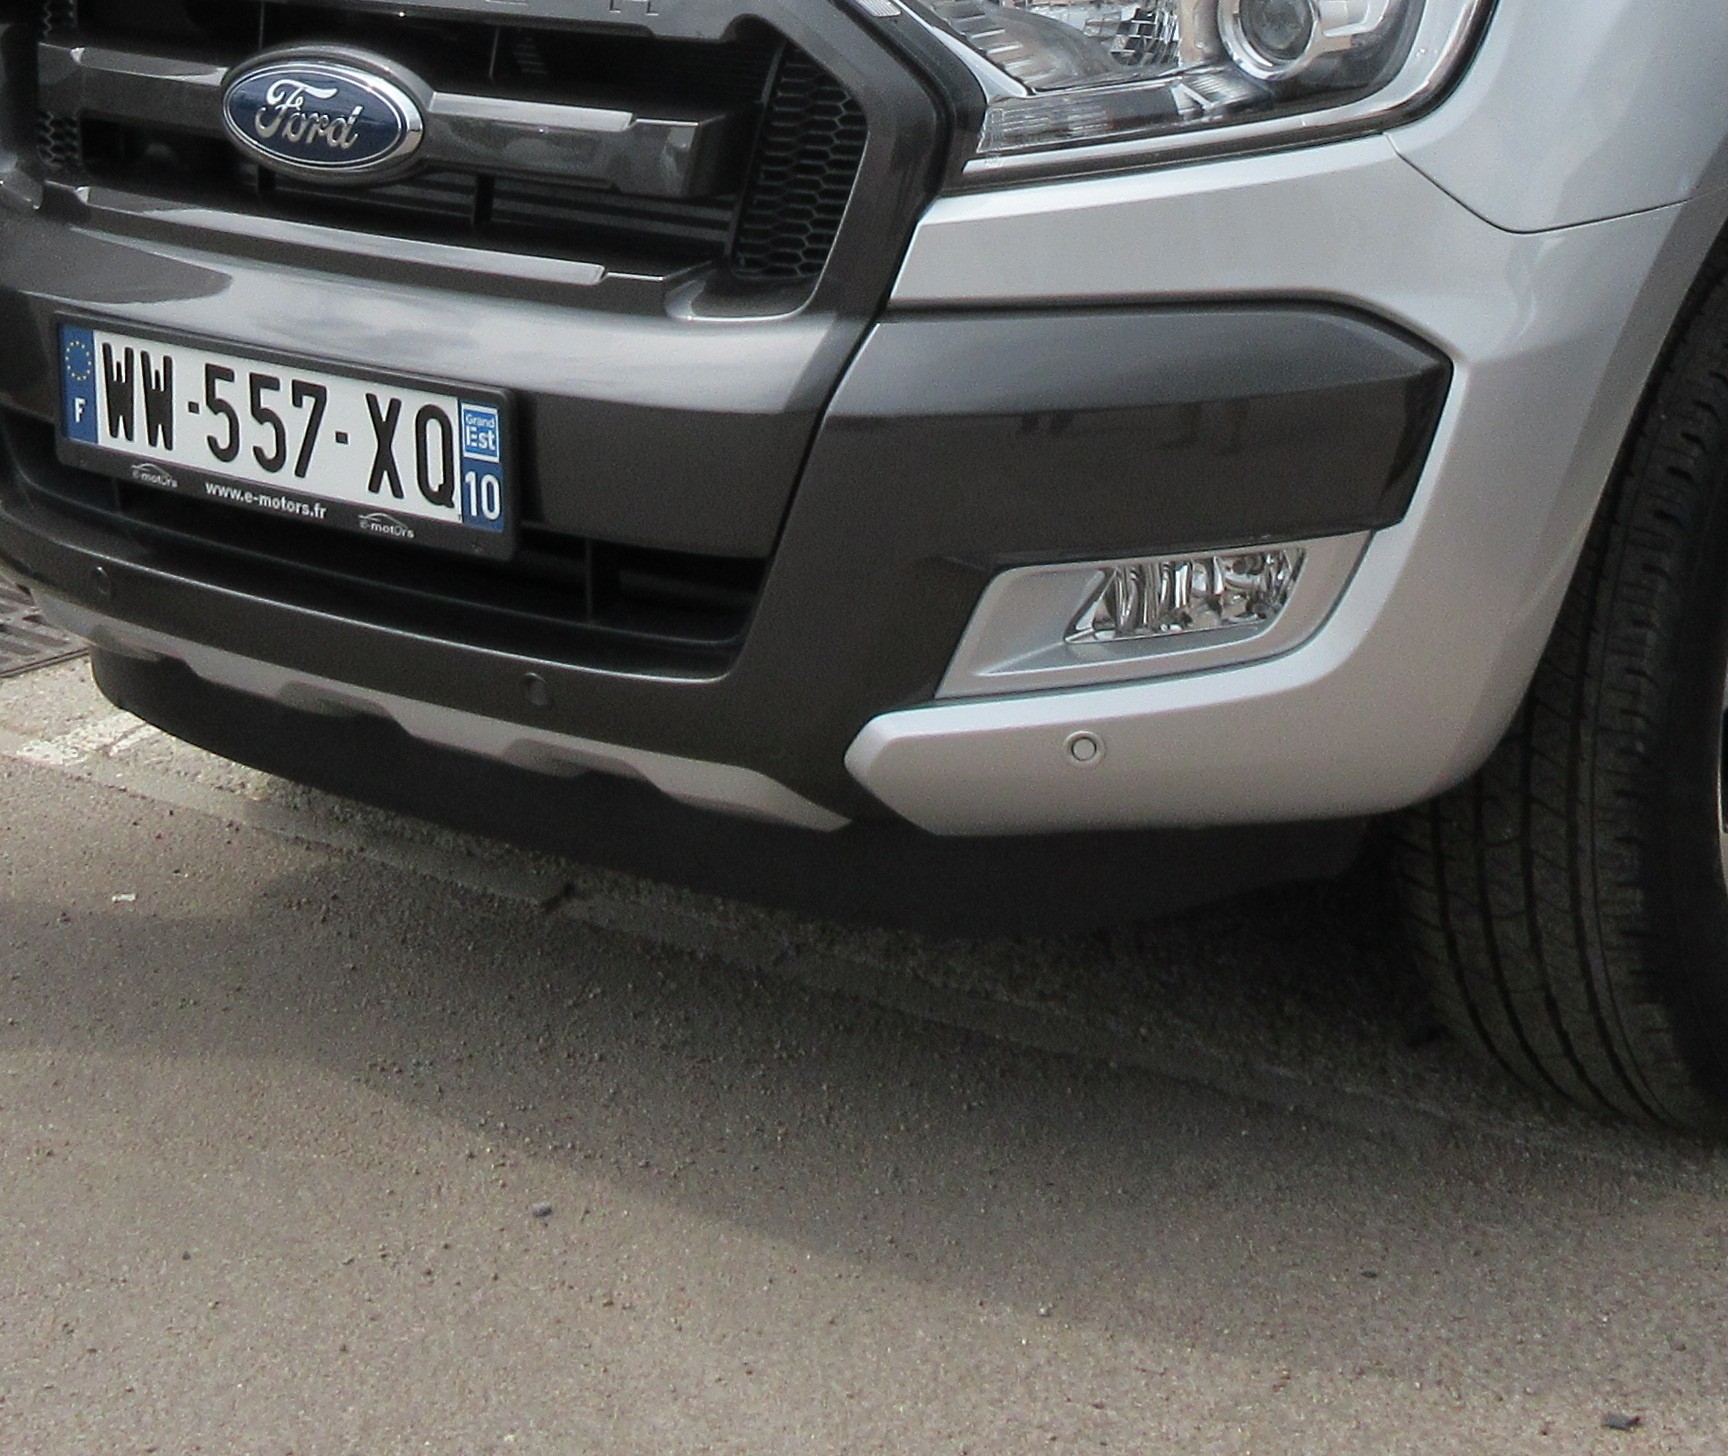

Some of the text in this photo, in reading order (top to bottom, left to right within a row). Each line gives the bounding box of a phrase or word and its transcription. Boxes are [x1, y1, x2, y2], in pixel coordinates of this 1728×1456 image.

[252, 77, 362, 152] Ford
[74, 397, 87, 423] F
[100, 341, 457, 509] WW-557-XQ
[465, 411, 496, 429] Grand
[465, 424, 497, 452] Est
[204, 479, 328, 521] www.e-motors.fr
[464, 470, 502, 521] 10
